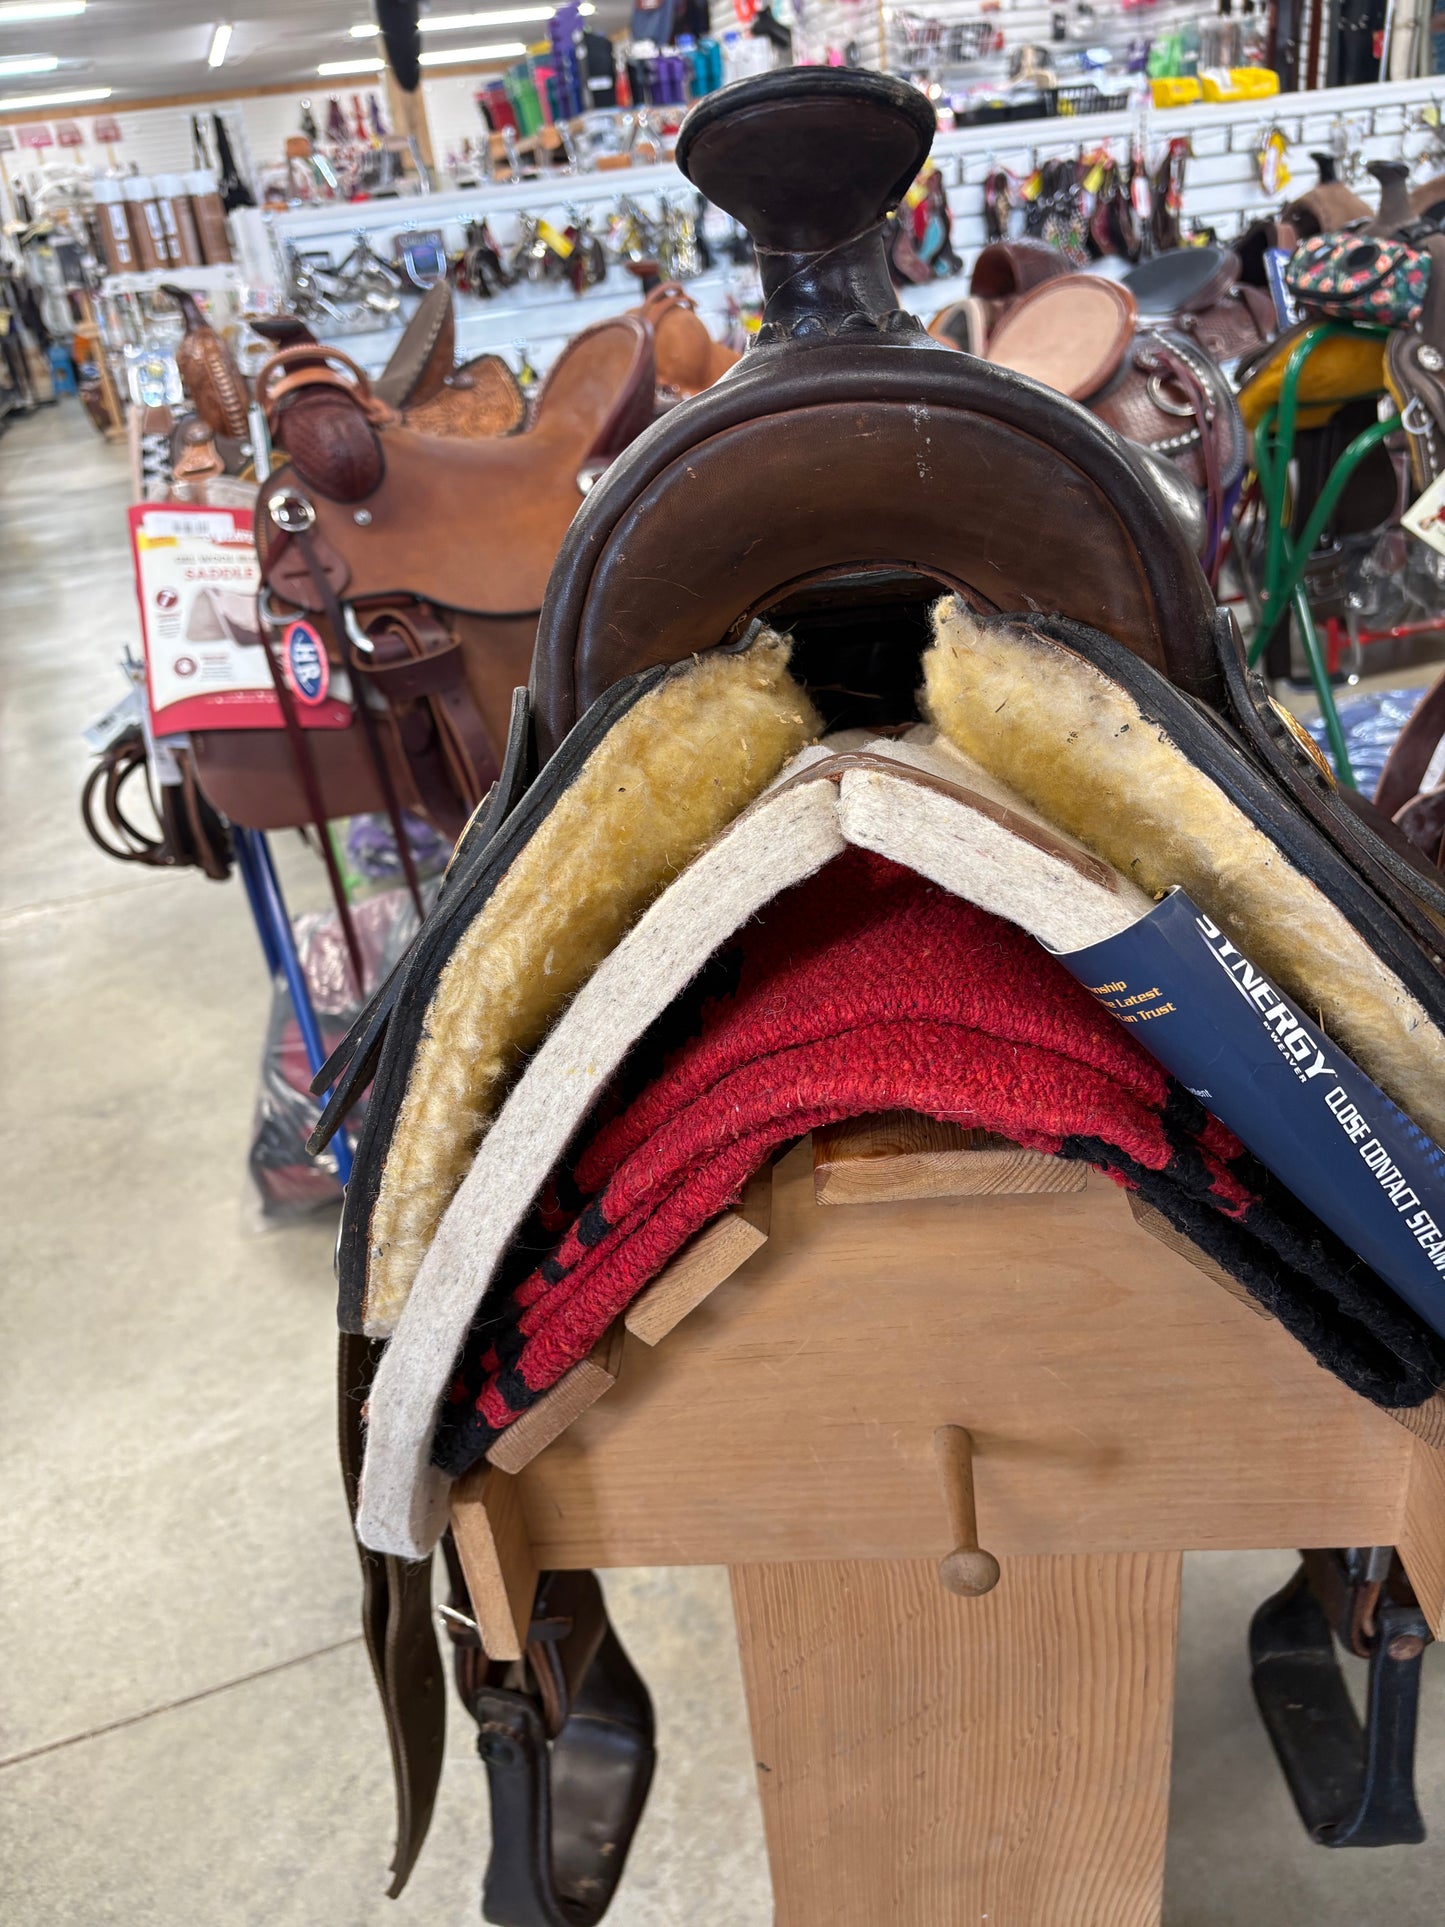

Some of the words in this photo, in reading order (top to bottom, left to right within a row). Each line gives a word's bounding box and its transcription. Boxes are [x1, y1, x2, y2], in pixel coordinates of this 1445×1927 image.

[184, 565, 256, 581] SADDLE
[1115, 987, 1163, 1008] Latest
[1136, 1002, 1177, 1021] Trust
[1263, 1020, 1272, 1031] BY
[1270, 1032, 1307, 1083] WEAVER
[1324, 1086, 1371, 1144] CLOSE
[1359, 1138, 1421, 1213] CONTACT
